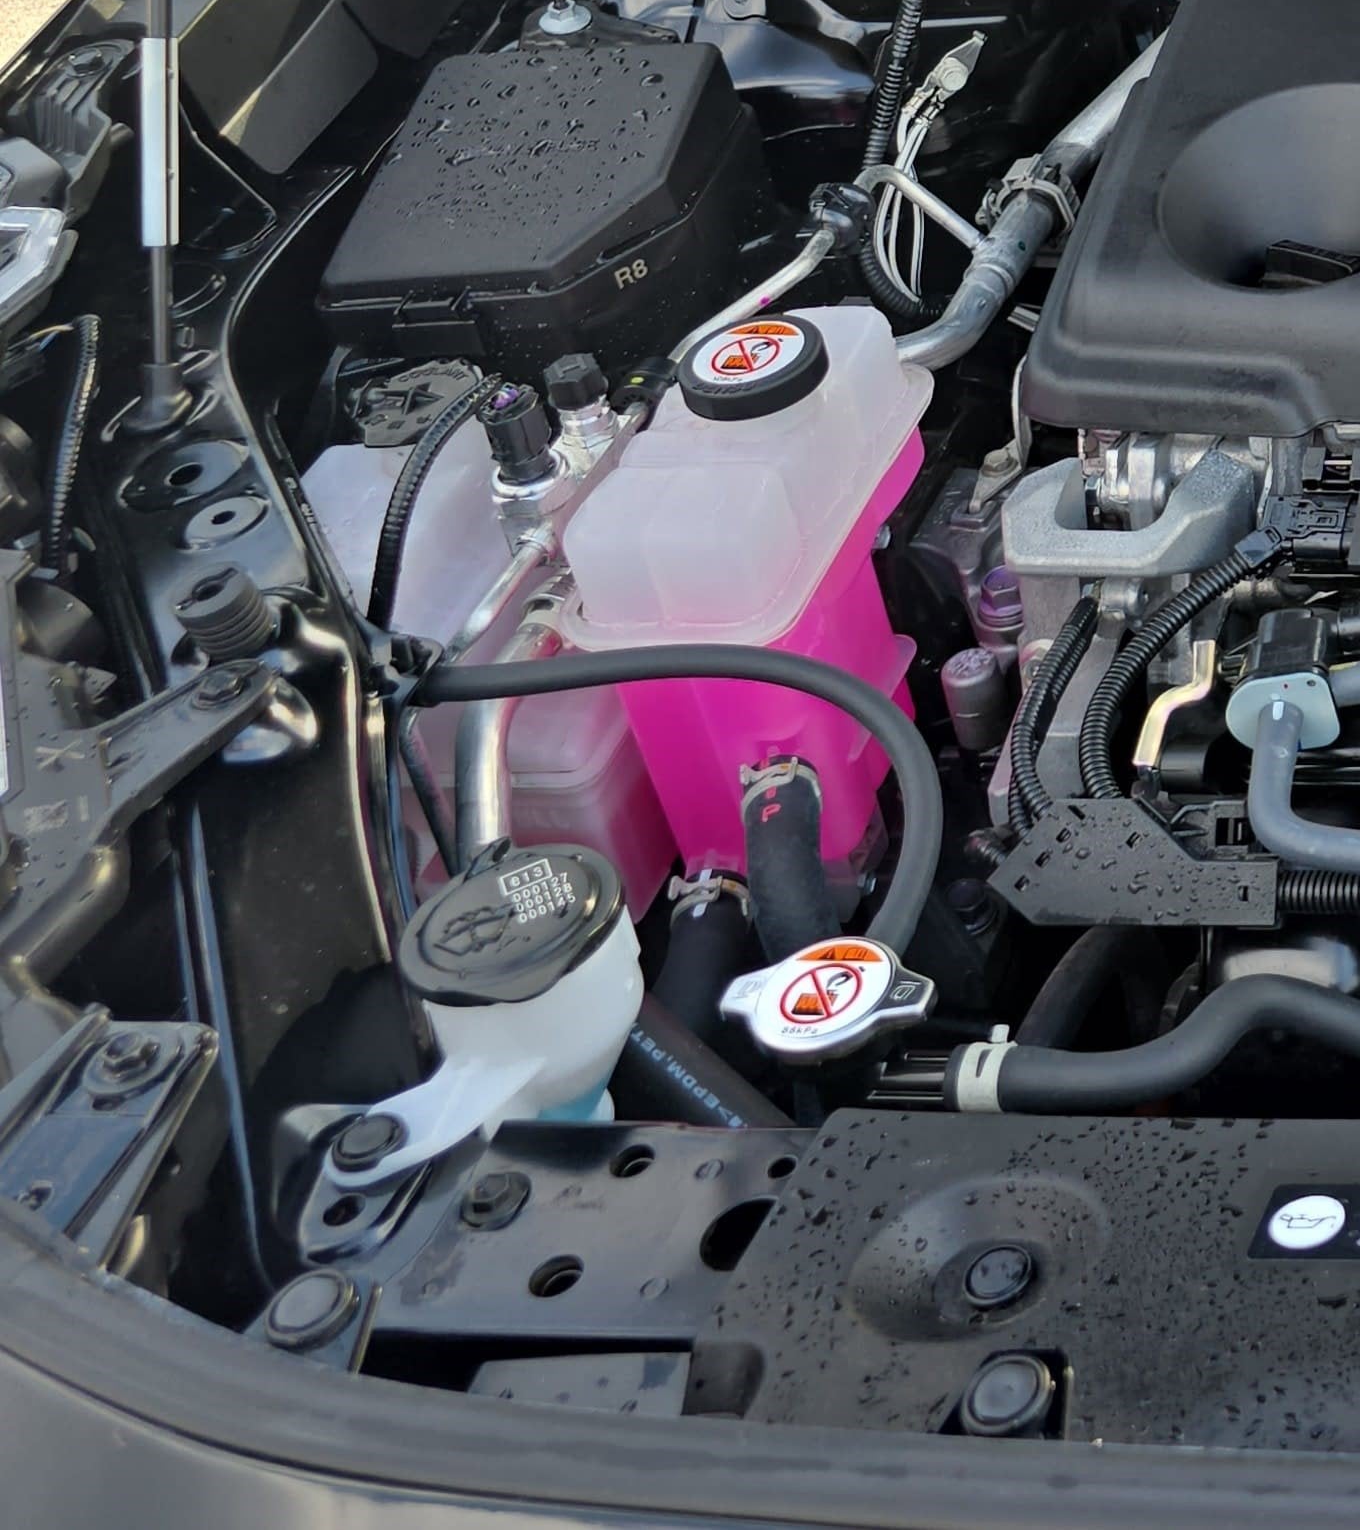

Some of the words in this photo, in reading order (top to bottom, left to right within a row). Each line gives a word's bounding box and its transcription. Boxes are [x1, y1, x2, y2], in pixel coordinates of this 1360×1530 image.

[614, 258, 648, 289] R8
[397, 366, 469, 383] COOLANT
[509, 866, 544, 887] e13
[513, 872, 568, 903] 000127
[516, 882, 573, 912] 000128
[519, 893, 576, 924] 000145
